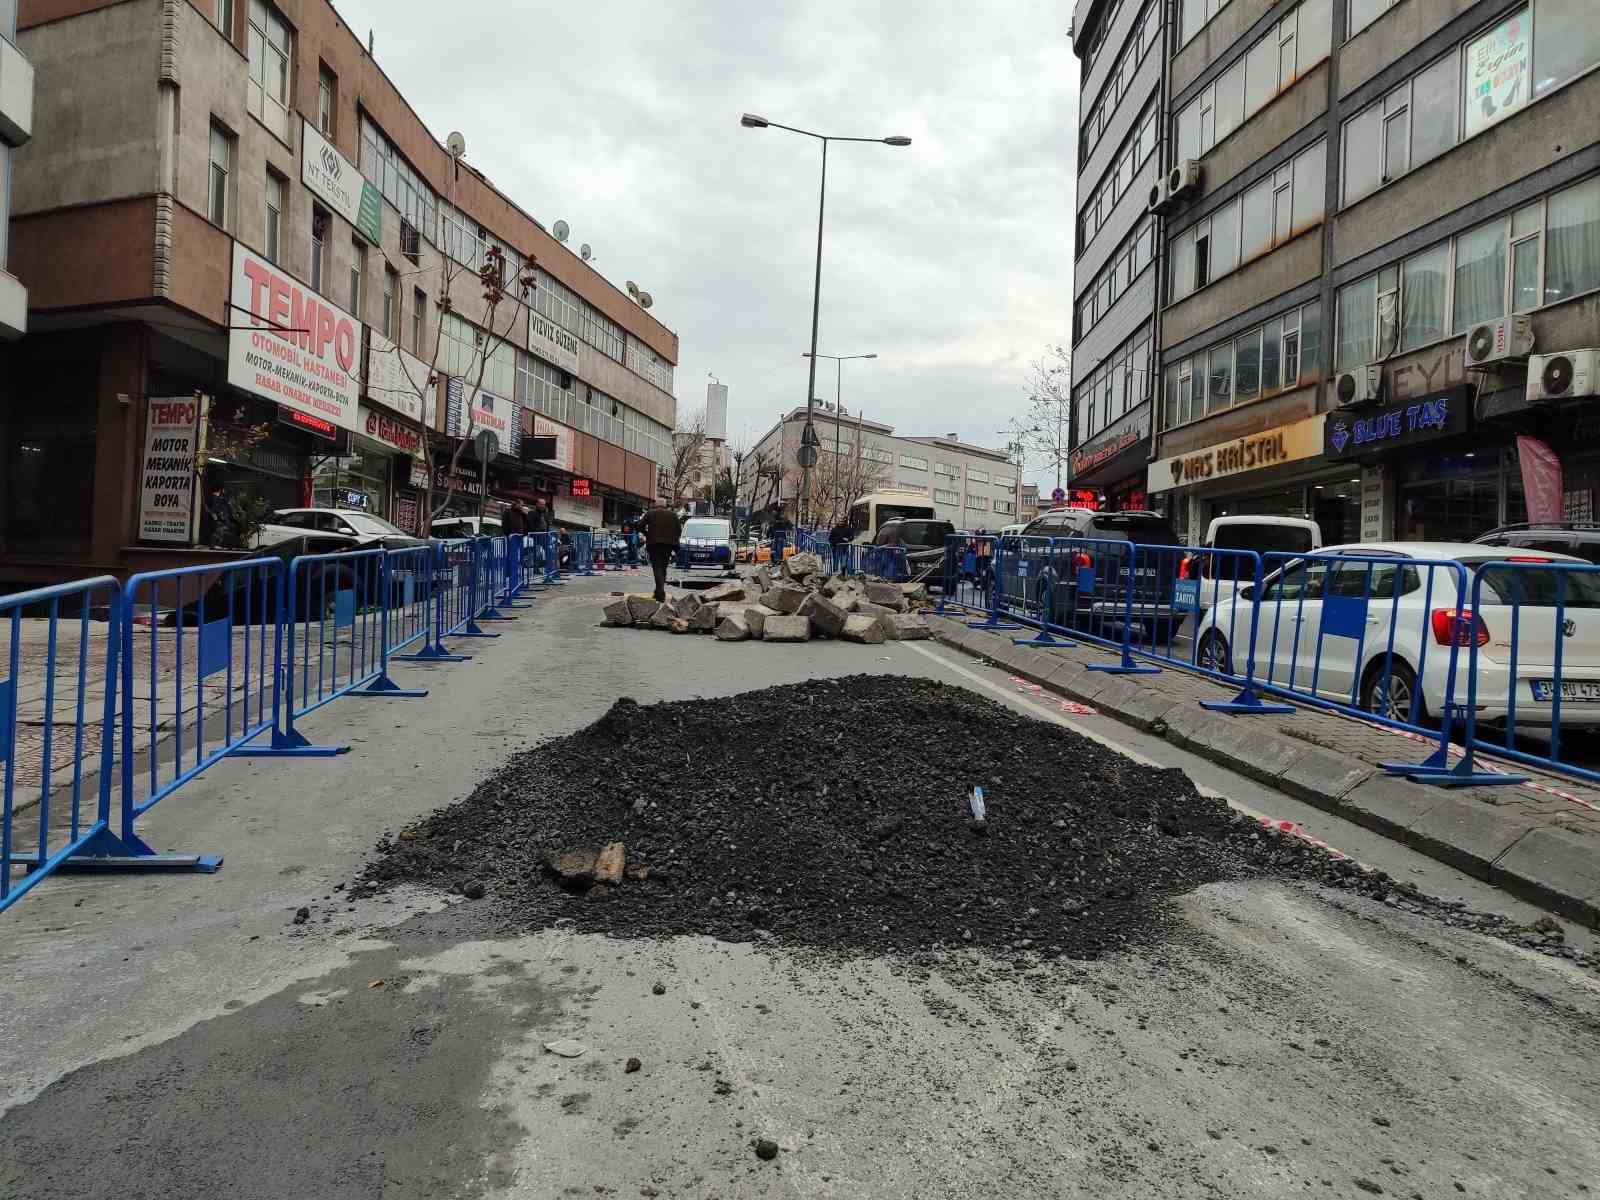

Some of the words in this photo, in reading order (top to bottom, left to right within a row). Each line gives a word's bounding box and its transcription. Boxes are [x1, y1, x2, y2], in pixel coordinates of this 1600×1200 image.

[243, 258, 354, 372] TEMPO
[251, 331, 302, 369] OTOMOBİL
[152, 403, 196, 425] TEMPO
[1353, 411, 1402, 444] BLUE
[1406, 398, 1449, 432] TAŞ
[152, 438, 189, 452] MOTOR
[146, 455, 193, 473] MEKANİK
[145, 475, 190, 490] KAPORTA
[153, 493, 179, 507] BOYA
